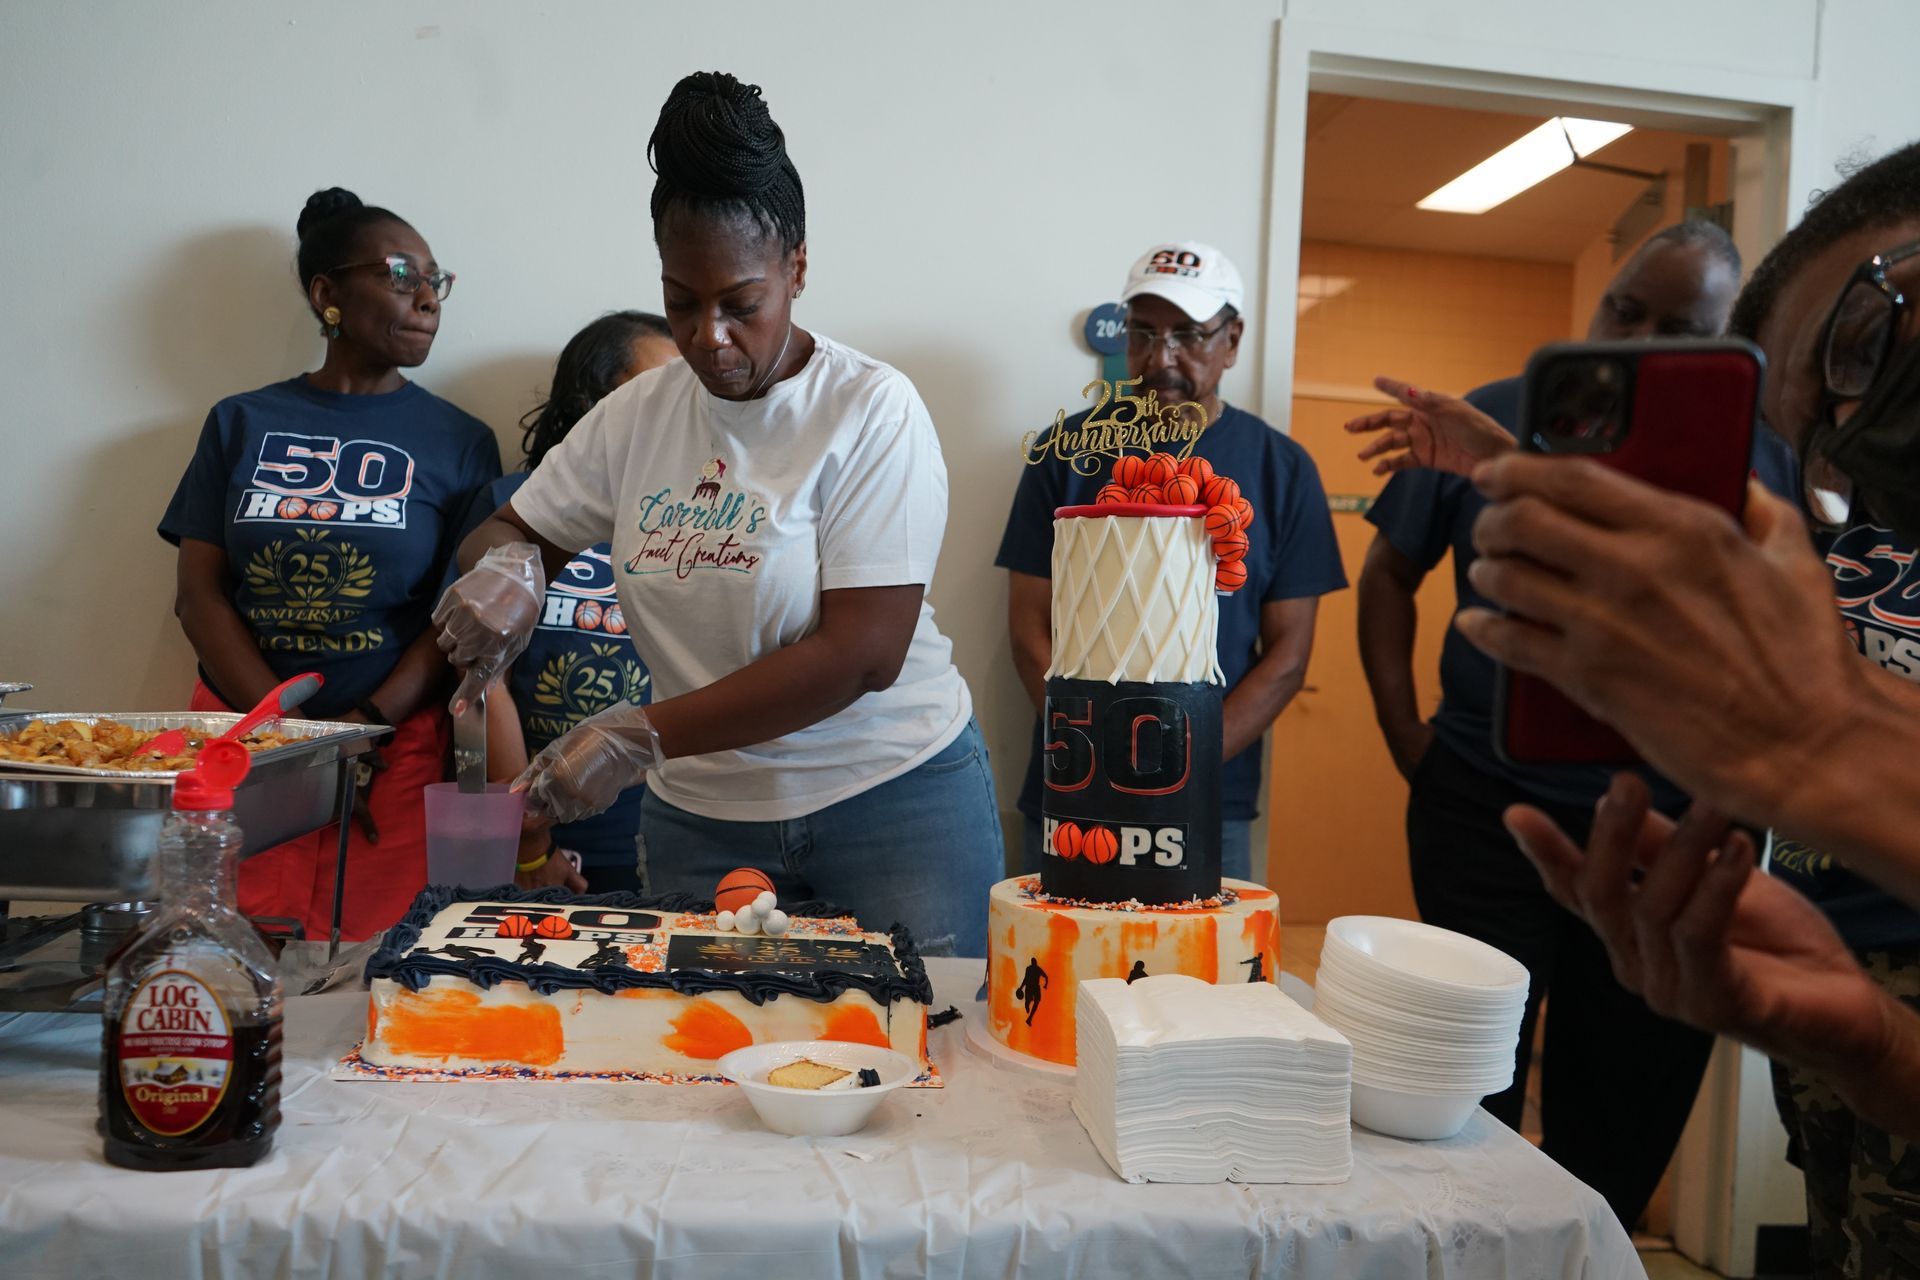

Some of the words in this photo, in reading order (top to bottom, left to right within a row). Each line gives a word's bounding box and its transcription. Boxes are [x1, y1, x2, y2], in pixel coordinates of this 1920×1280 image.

[1082, 375, 1160, 429] 25th
[1021, 402, 1208, 472] Anniversary
[252, 432, 414, 501] 50
[243, 492, 402, 524] HOOPS
[638, 488, 767, 534] Carroll's
[629, 530, 684, 572] Sweet
[677, 533, 760, 579] Creations
[542, 596, 628, 635] HOO
[1044, 696, 1192, 796] 50
[1042, 816, 1184, 867] HOOPS
[458, 915, 648, 944] HOOPS
[149, 984, 199, 1009] LOG
[137, 1007, 214, 1033] CABIN
[135, 1086, 209, 1106] Original
